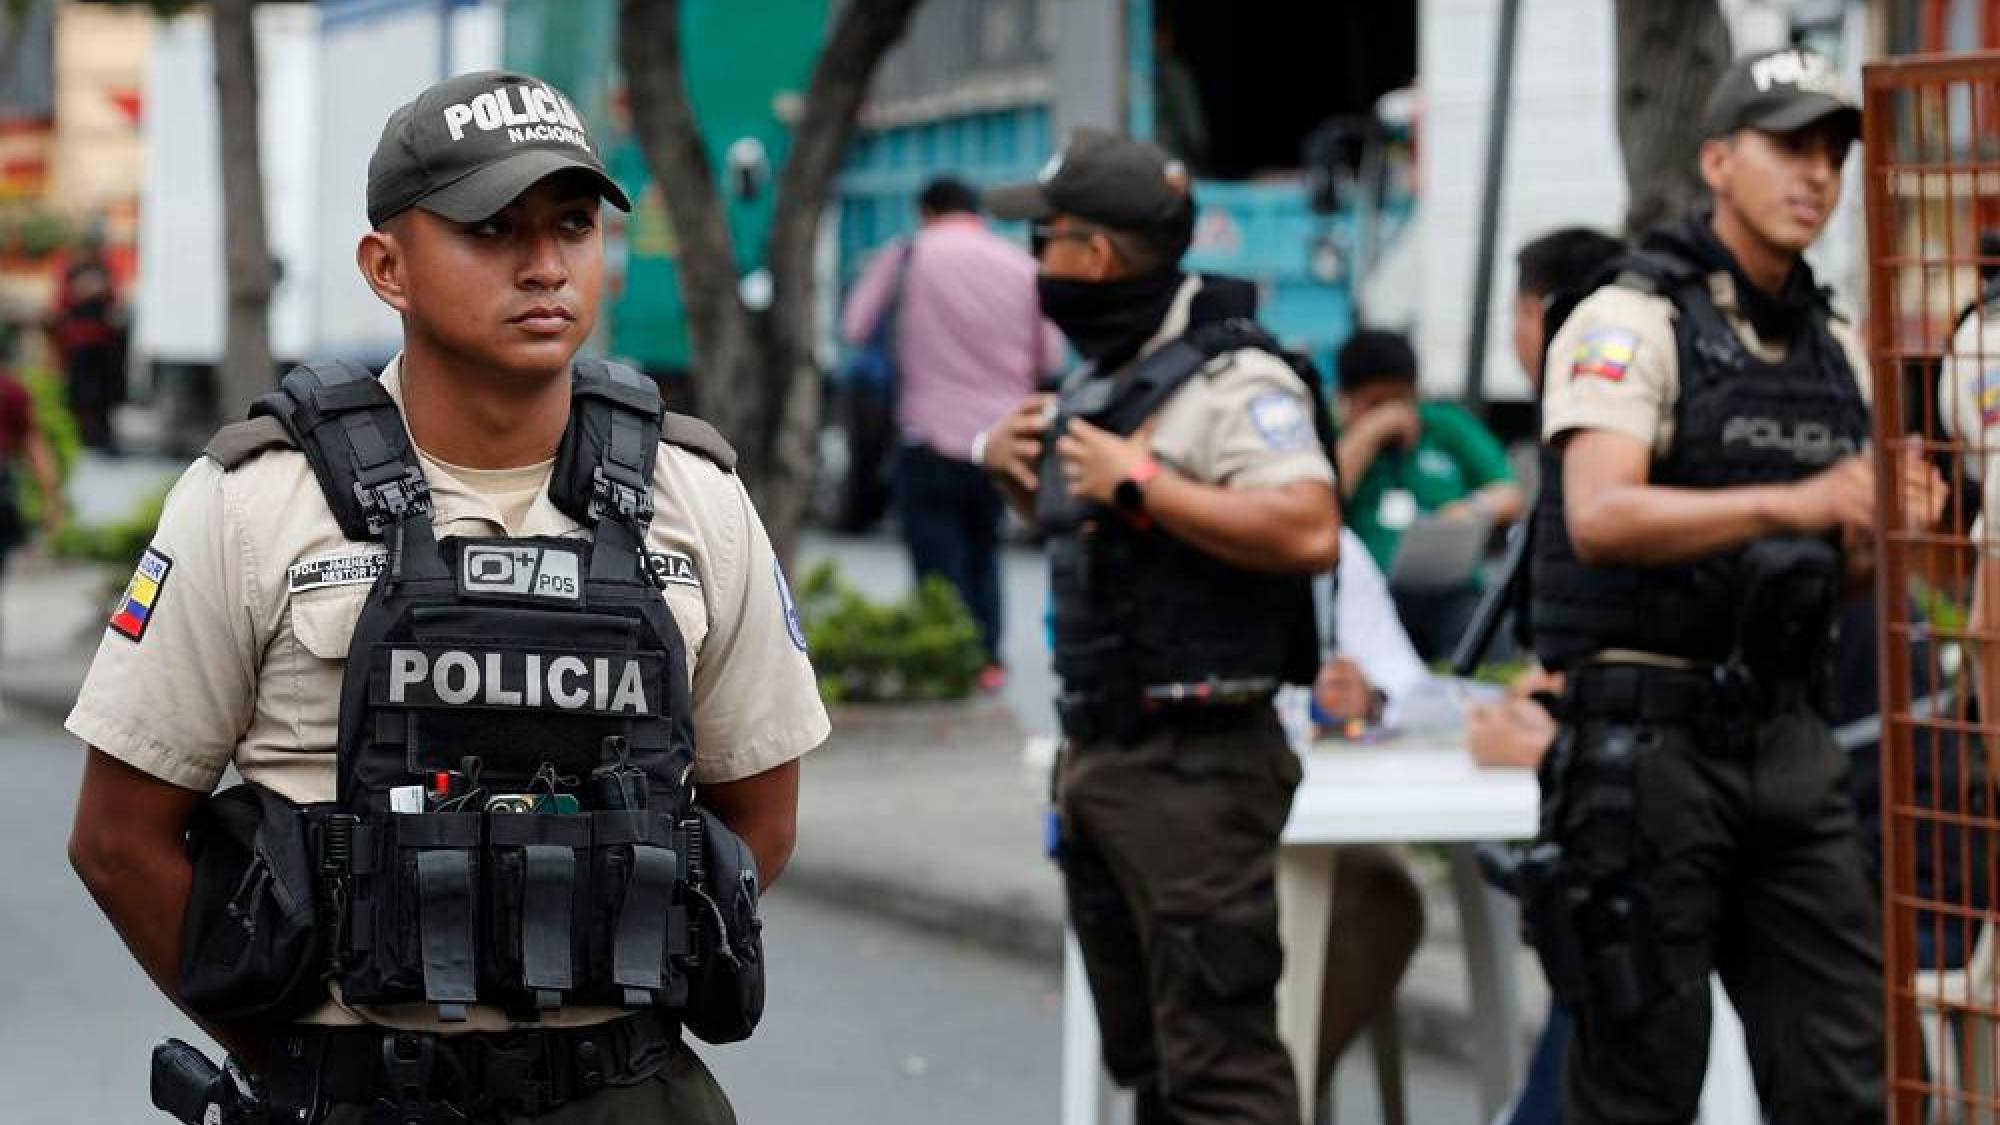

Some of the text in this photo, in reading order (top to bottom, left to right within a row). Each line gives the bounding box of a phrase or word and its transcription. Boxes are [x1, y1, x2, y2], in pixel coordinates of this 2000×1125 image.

[507, 125, 591, 152] NACIONAL
[539, 574, 576, 593] POS
[389, 649, 649, 714] POLICIA
